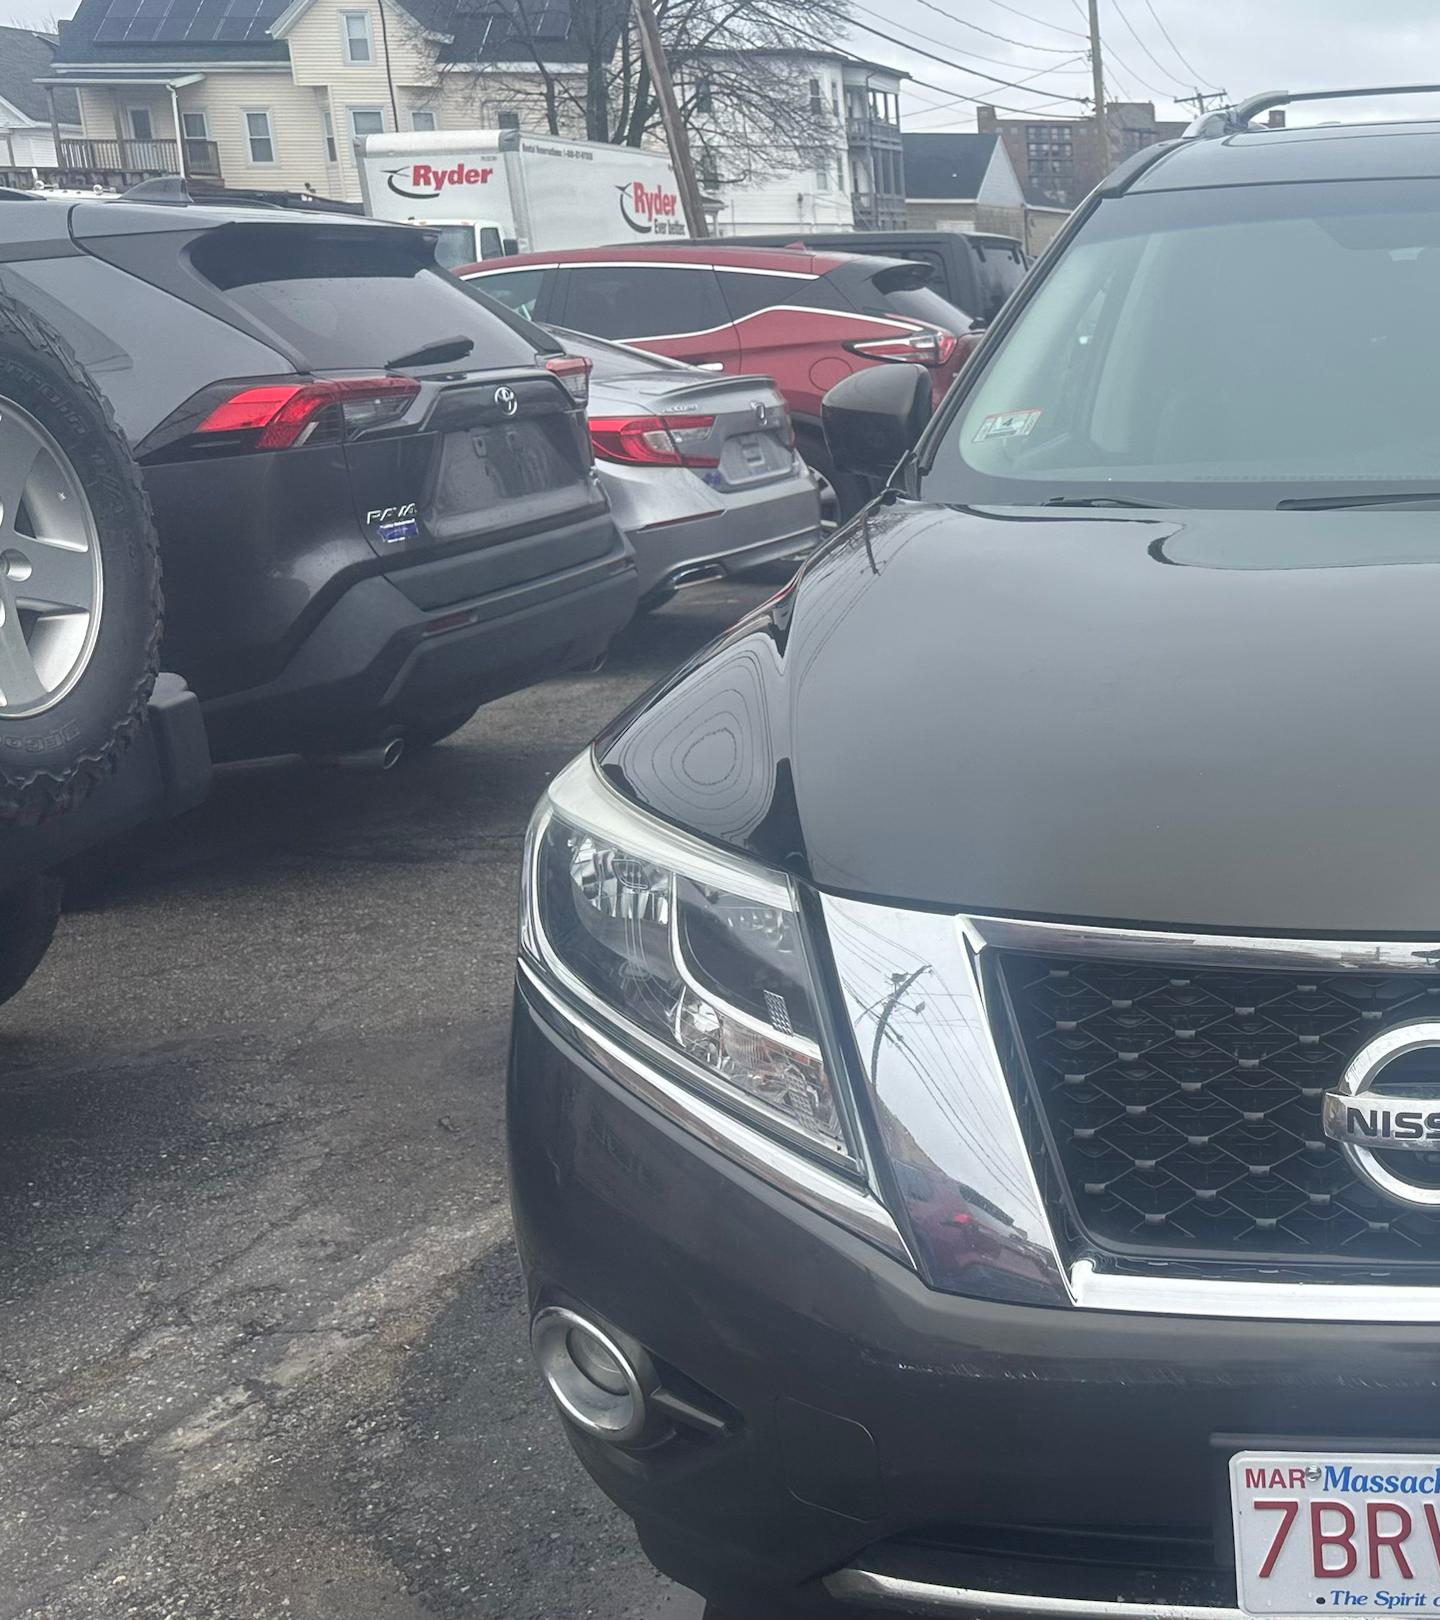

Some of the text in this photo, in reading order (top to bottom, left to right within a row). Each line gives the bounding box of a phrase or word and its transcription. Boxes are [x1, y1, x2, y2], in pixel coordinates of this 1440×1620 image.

[412, 163, 493, 191] Ryder
[633, 182, 677, 222] Ryder
[1245, 1468, 1306, 1489] MAR
[1330, 1590, 1368, 1606] The
[1374, 1590, 1427, 1609] Spirit
